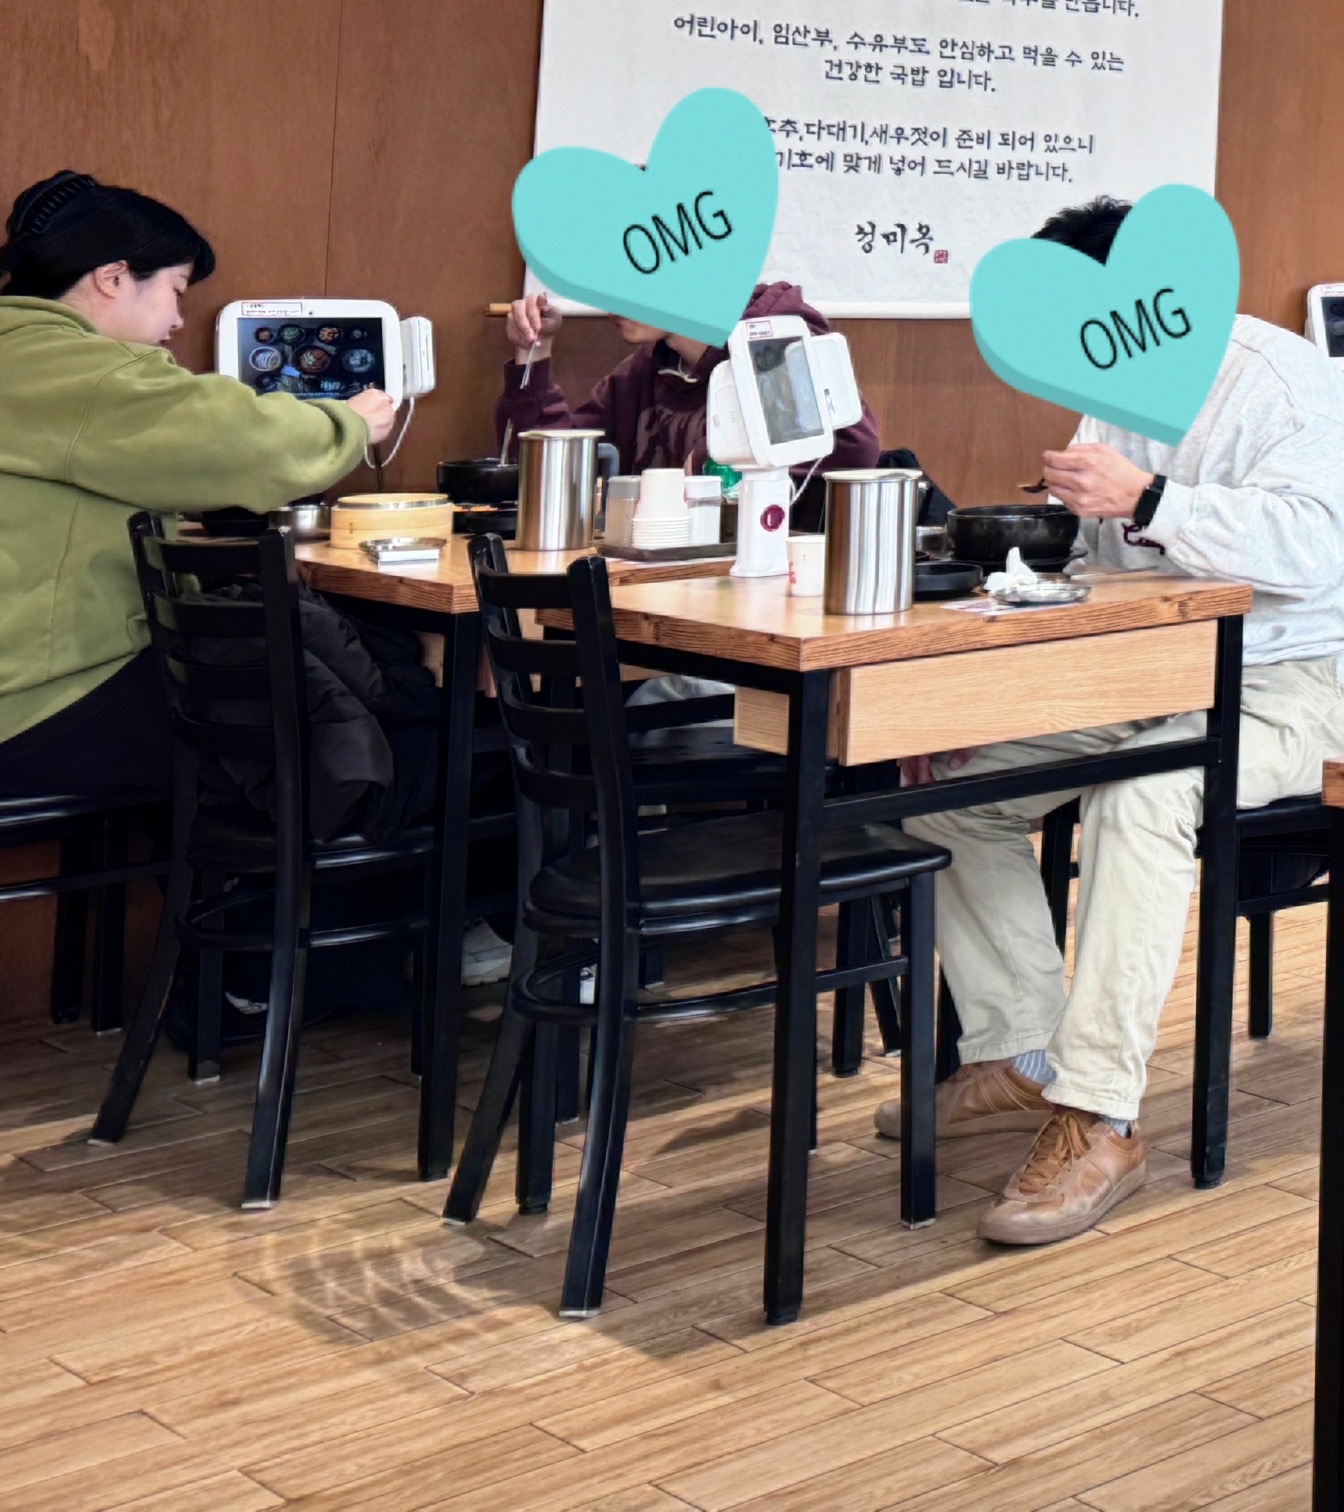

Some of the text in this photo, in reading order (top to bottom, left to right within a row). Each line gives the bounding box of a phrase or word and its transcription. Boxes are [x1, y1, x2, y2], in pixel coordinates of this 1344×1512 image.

[673, 13, 1124, 72] 어린아이, 임산부, 수유부도 안심하고 먹을 수 있는
[824, 59, 996, 93] 건강한 국밥 입니다.
[954, 129, 991, 149] 준비
[998, 131, 1036, 152] 되어
[1044, 133, 1094, 154] 있으니
[775, 148, 1073, 183] 기호에 맞게 넣어 드시길 바랍니다.
